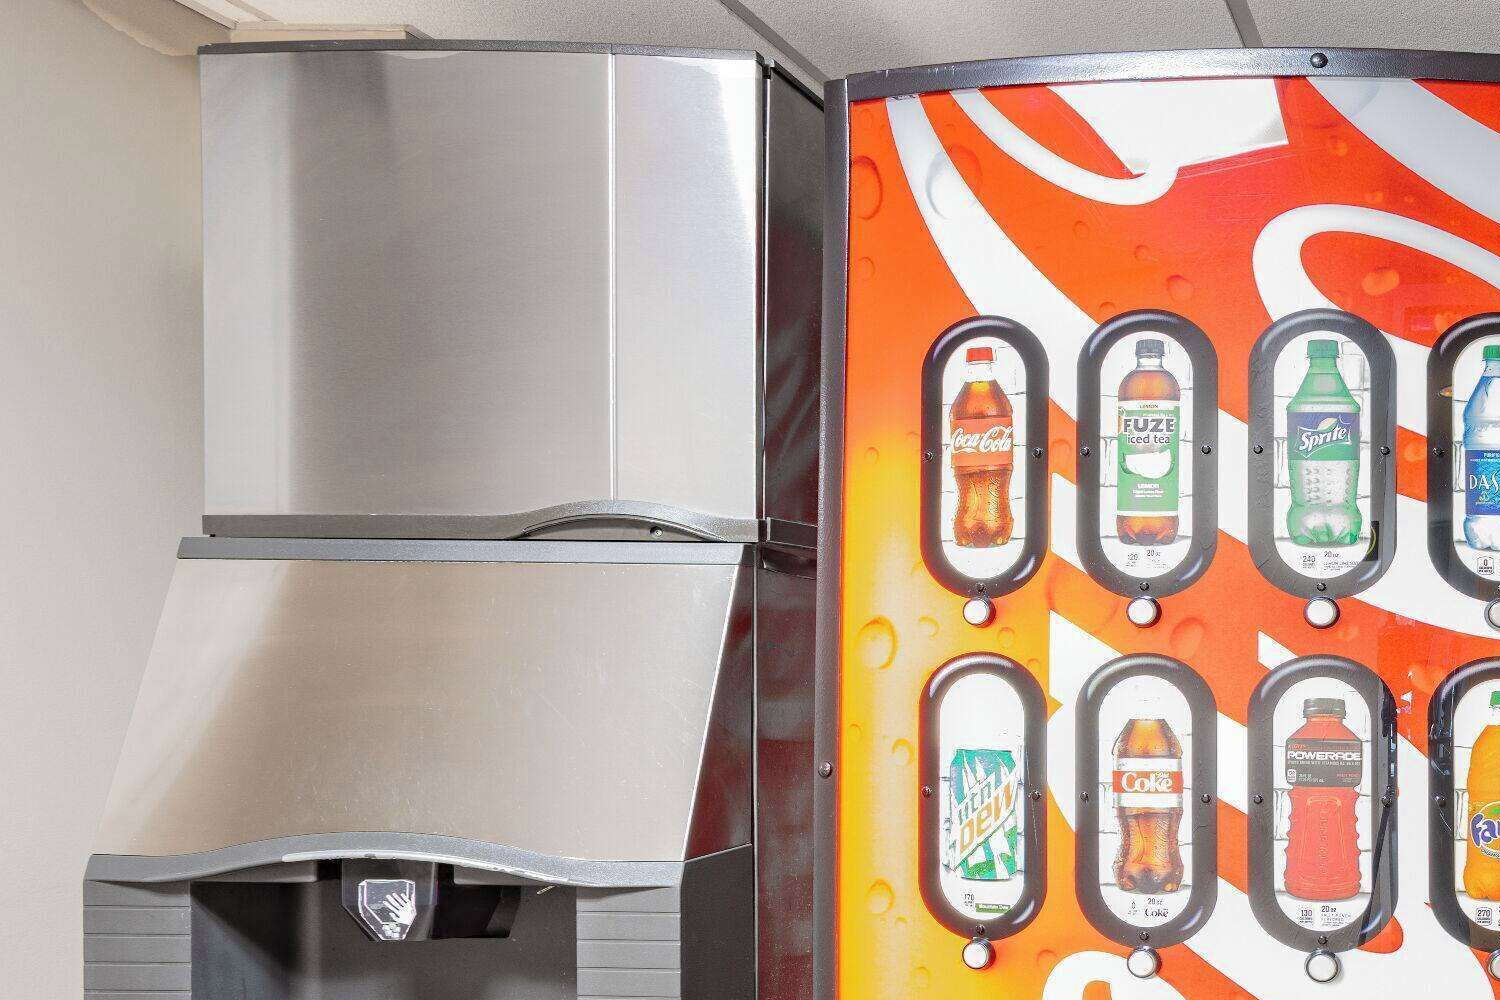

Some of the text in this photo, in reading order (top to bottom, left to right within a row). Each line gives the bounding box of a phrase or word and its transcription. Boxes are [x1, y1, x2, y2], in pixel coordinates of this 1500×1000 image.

[1123, 418, 1175, 433] FUZE
[951, 424, 1014, 454] Coca-Cola
[1127, 434, 1170, 444] iced tea
[1299, 425, 1347, 452] Sprite
[1146, 549, 1155, 557] 20
[1302, 555, 1316, 563] 240
[1324, 550, 1332, 558] 20
[1287, 751, 1363, 761] POWERADE
[1121, 771, 1172, 793] Coke
[1147, 897, 1156, 905] 20
[1144, 907, 1169, 918] Coke
[1301, 909, 1313, 917] 130
[1321, 905, 1330, 913] 20
[1477, 909, 1491, 917] 270
